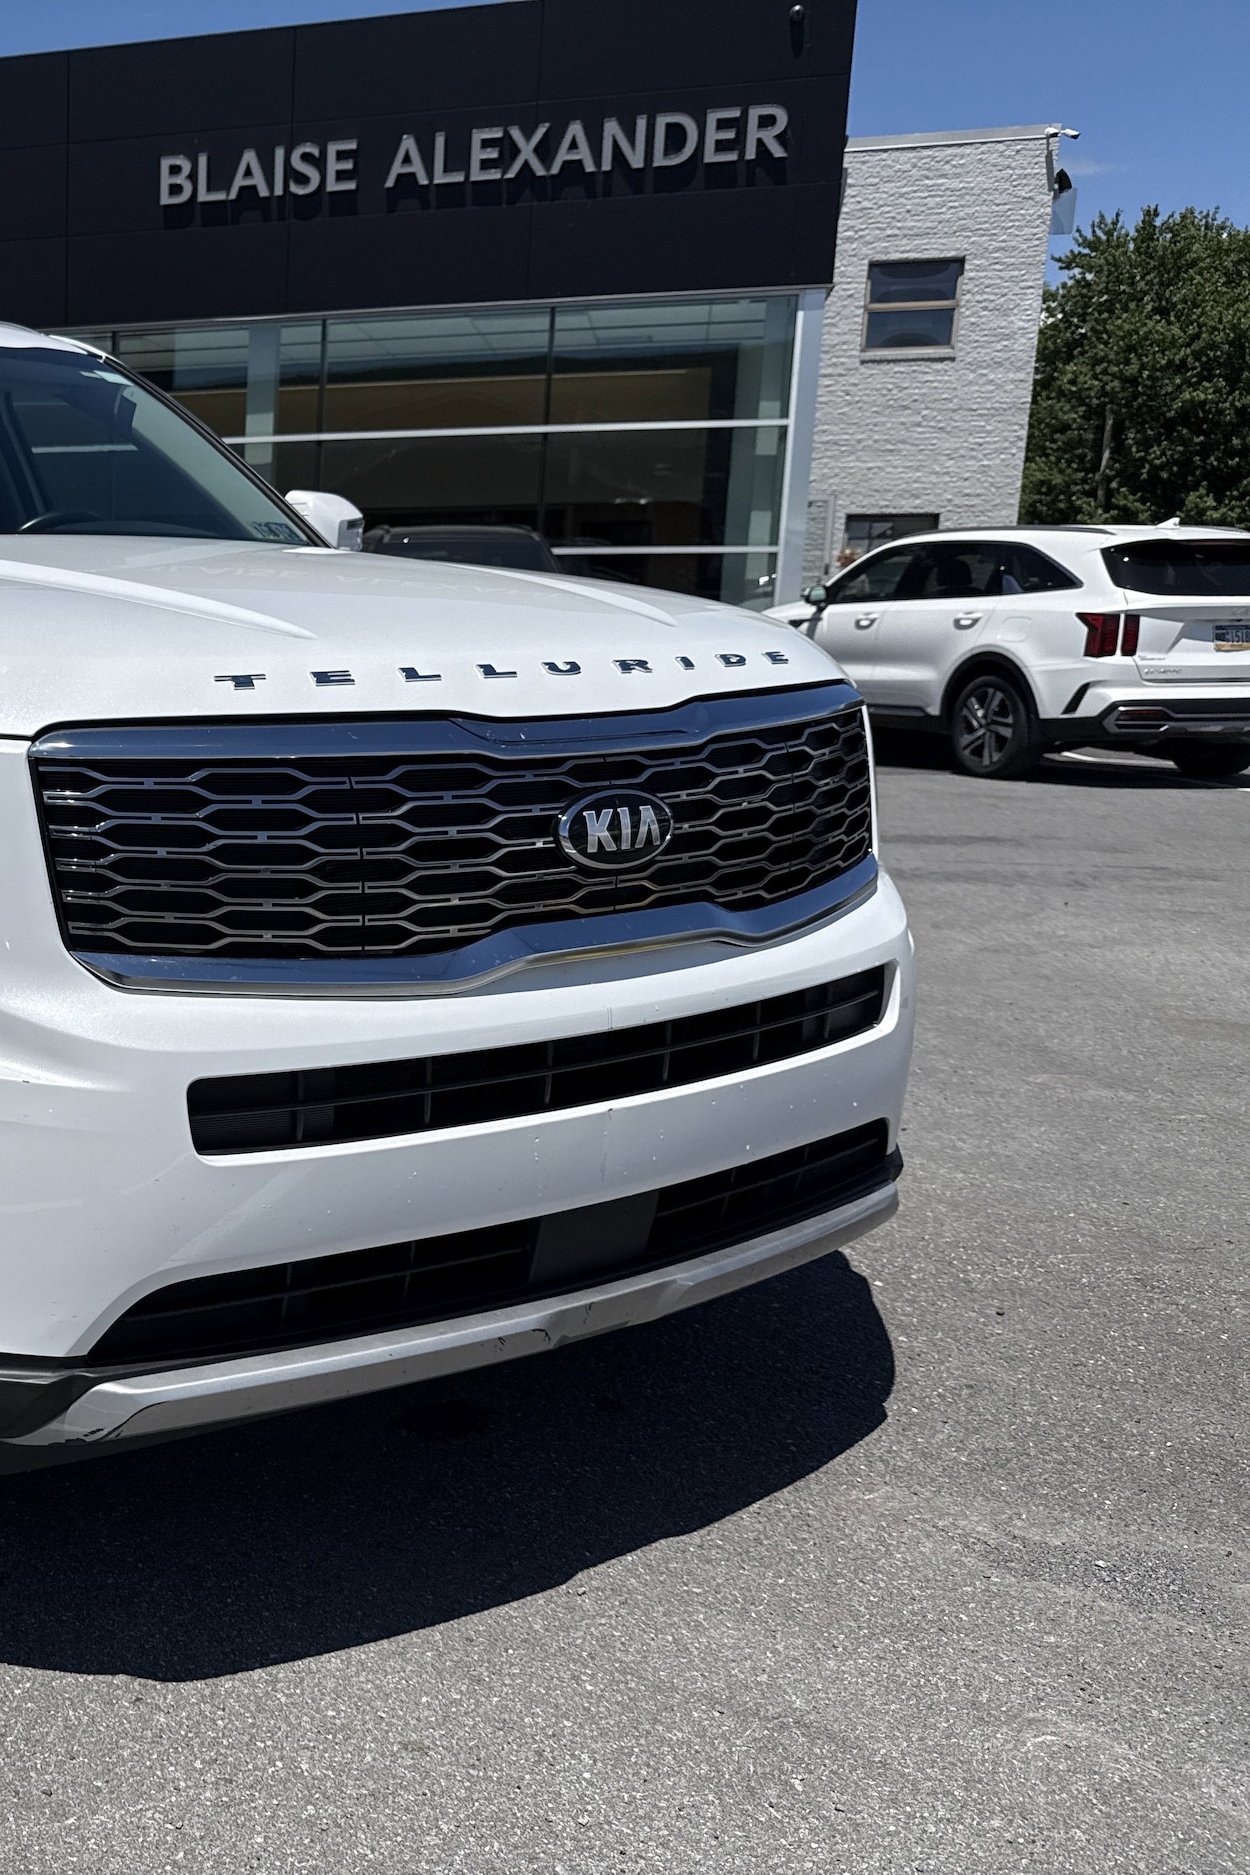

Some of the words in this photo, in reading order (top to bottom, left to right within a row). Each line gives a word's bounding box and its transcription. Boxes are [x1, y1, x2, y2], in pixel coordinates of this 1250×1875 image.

[158, 139, 358, 206] BLAISE
[384, 103, 789, 188] ALEXANDER
[214, 650, 790, 691] TELLURIDE
[583, 805, 661, 853] KIA
